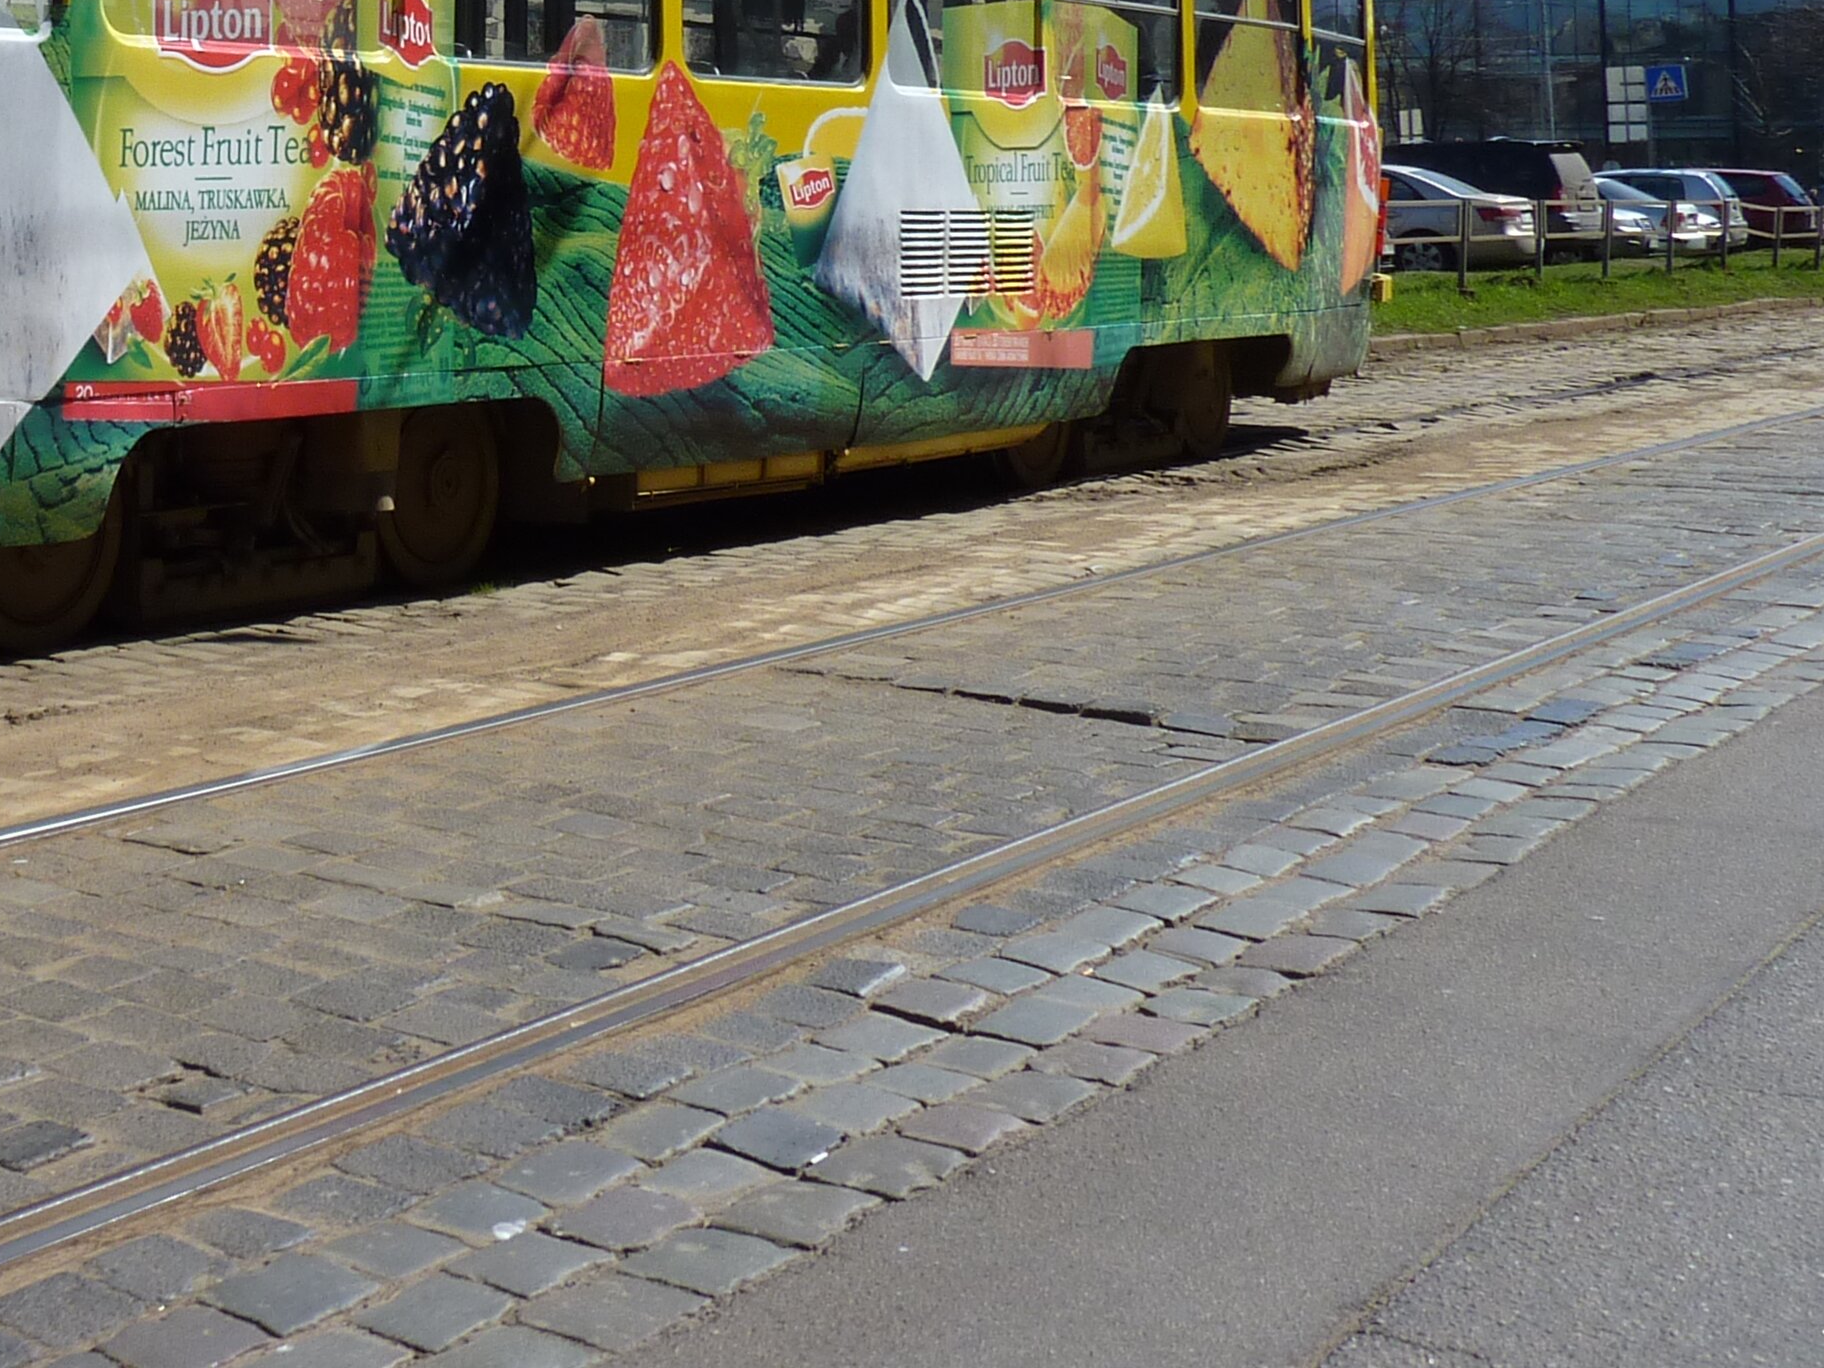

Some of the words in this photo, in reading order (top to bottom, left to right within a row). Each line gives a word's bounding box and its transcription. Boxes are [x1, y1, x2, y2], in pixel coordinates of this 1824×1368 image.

[163, 0, 263, 51] Lipton
[988, 60, 1039, 97] Lipton
[119, 128, 196, 168] Forest
[200, 126, 263, 166] Fruit
[267, 125, 312, 165] Tea
[792, 177, 831, 202] Lipton
[965, 151, 1018, 195] Tropical
[1021, 154, 1051, 182] Fruit
[1052, 152, 1076, 181] Tea
[135, 190, 195, 214] MALINA,
[198, 188, 291, 212] TRUSKAWKA,
[183, 216, 241, 247] JEŻYNA
